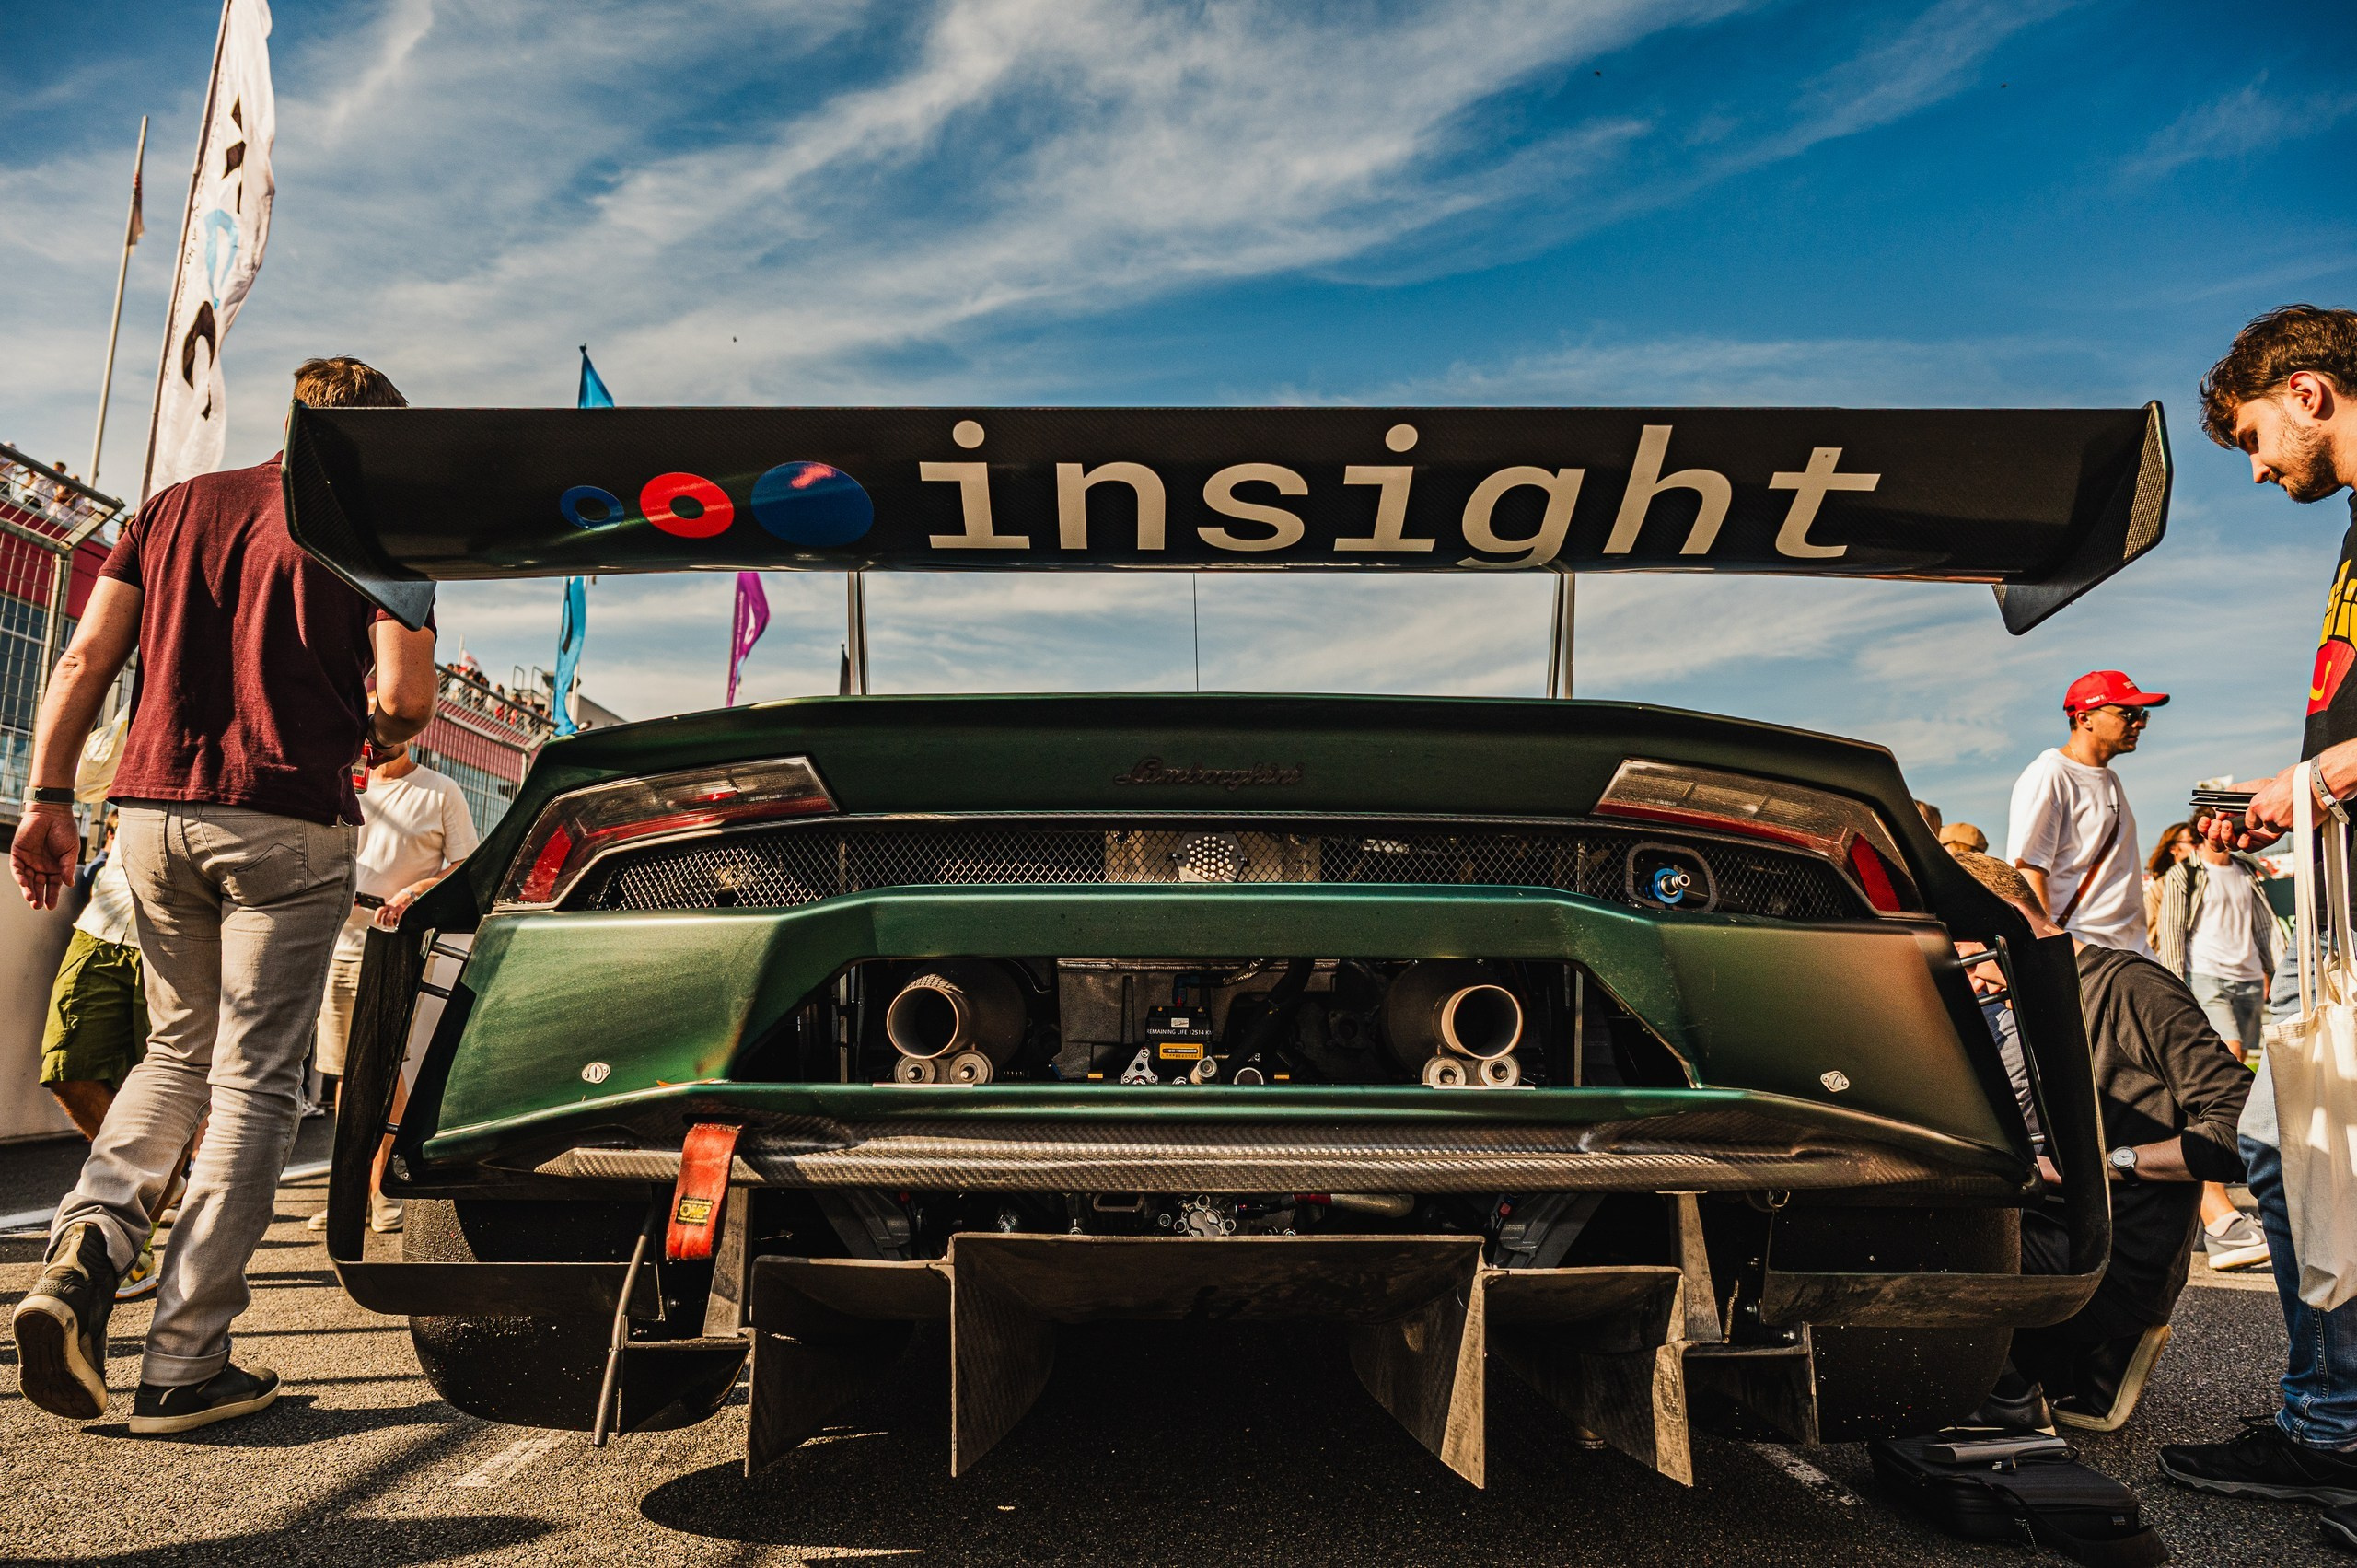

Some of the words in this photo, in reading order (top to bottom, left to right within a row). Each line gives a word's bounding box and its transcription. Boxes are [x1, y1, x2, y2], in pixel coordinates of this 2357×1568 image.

[919, 420, 1881, 569] insight
[1113, 756, 1306, 792] Lamborghini
[679, 1204, 712, 1219] OMP
